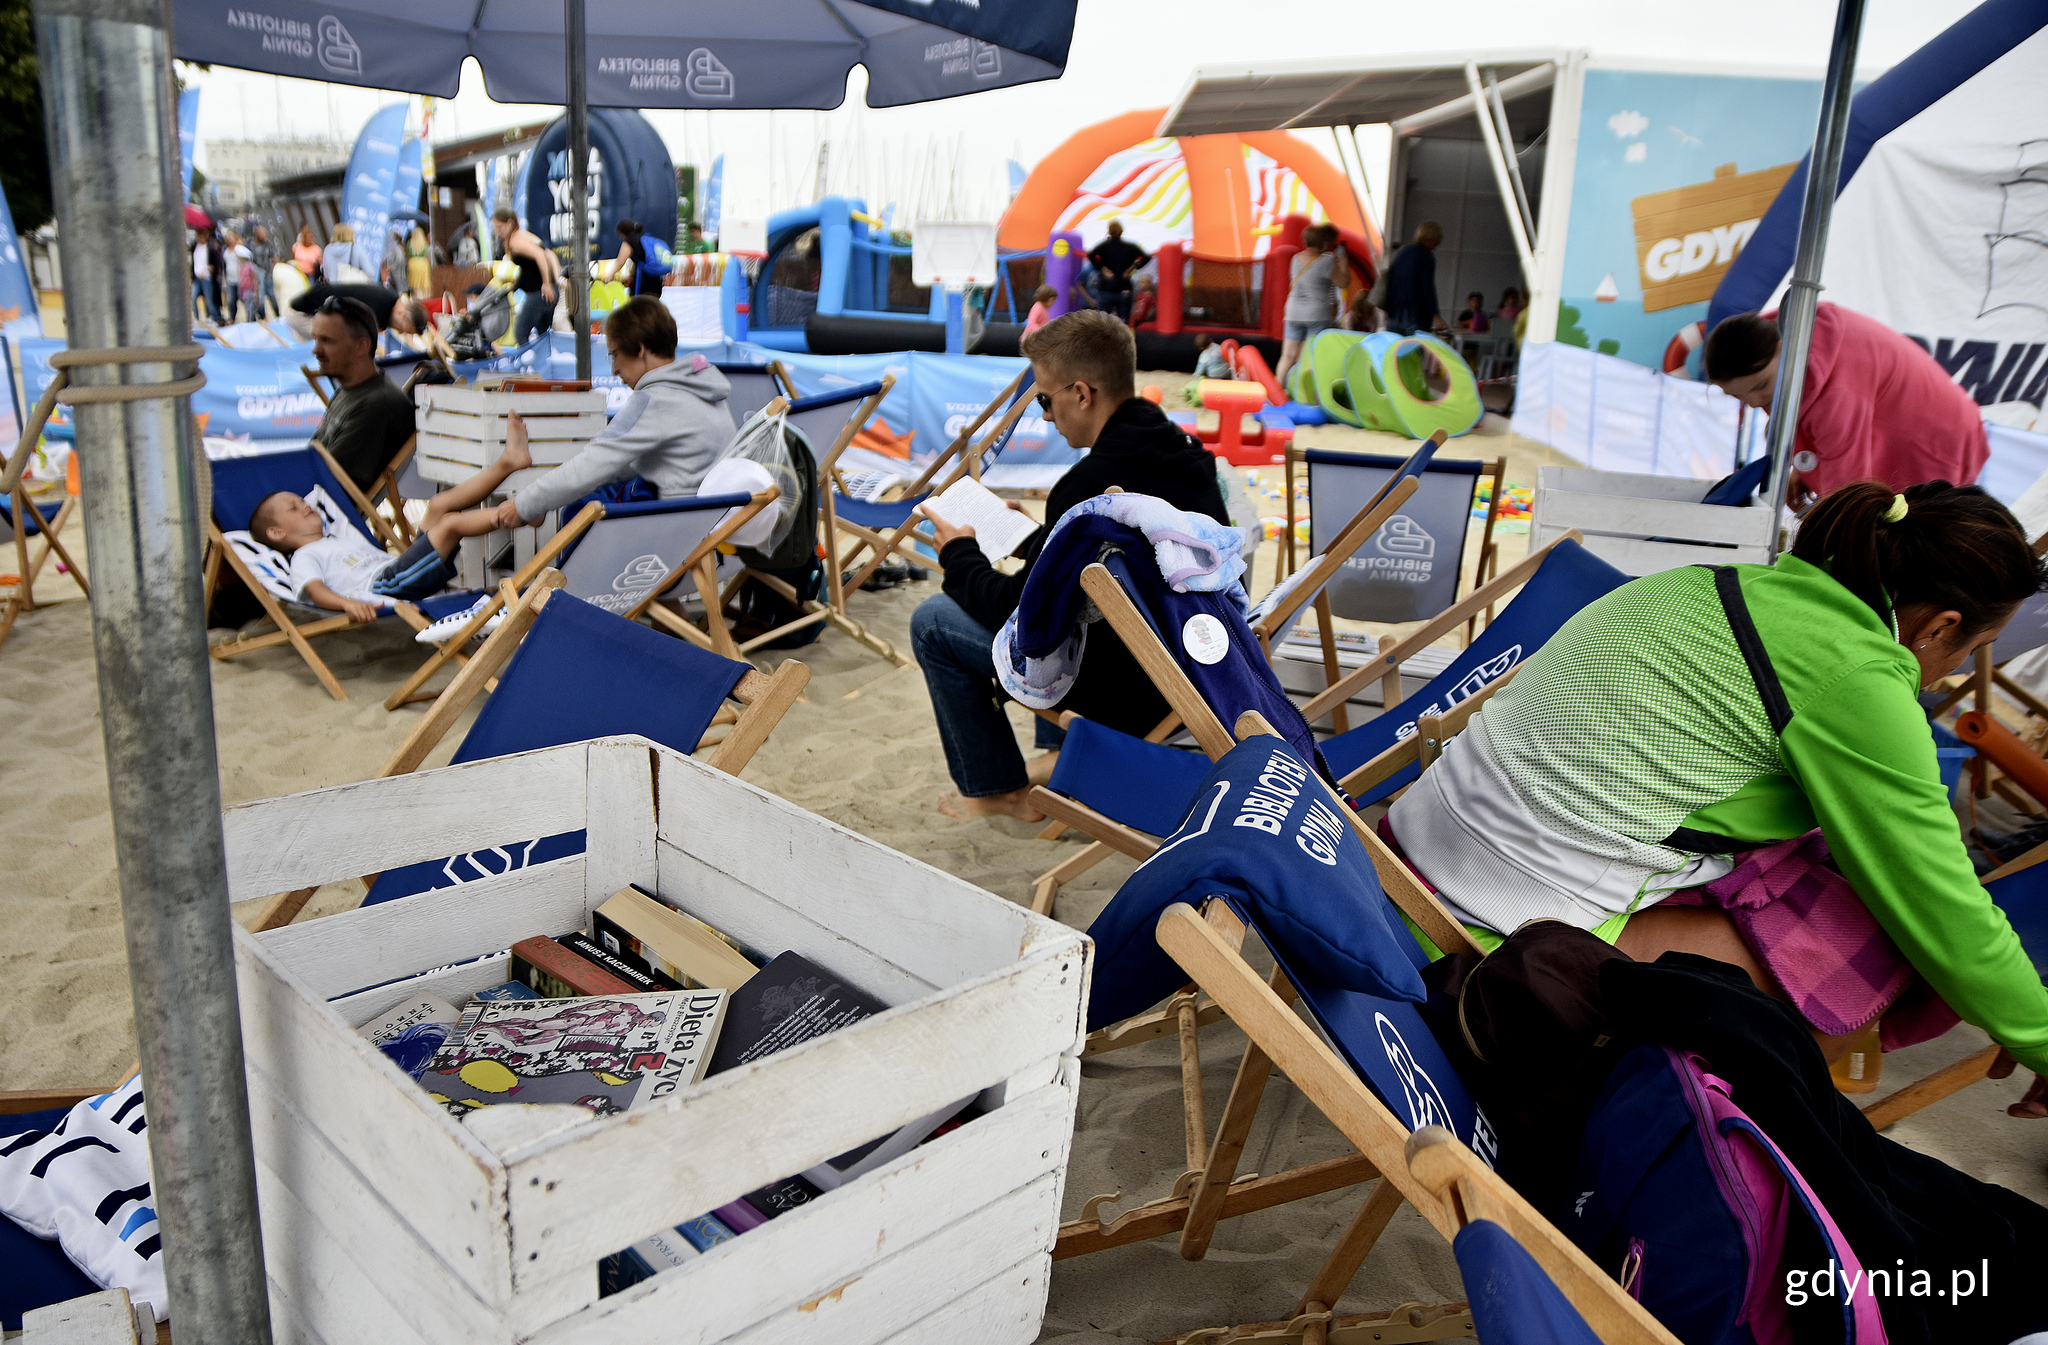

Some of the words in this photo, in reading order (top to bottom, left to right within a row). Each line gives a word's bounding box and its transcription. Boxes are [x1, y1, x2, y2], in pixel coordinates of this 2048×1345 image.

[235, 384, 280, 396] VOLVO
[1295, 798, 1345, 866] GDYNIA
[574, 940, 607, 958] JANUSZ
[603, 955, 654, 985] KACZMAREK
[670, 993, 721, 1053] Dieta
[737, 1050, 750, 1060] Lady
[749, 1032, 773, 1051] Catherine
[650, 1232, 677, 1258] FRAZ
